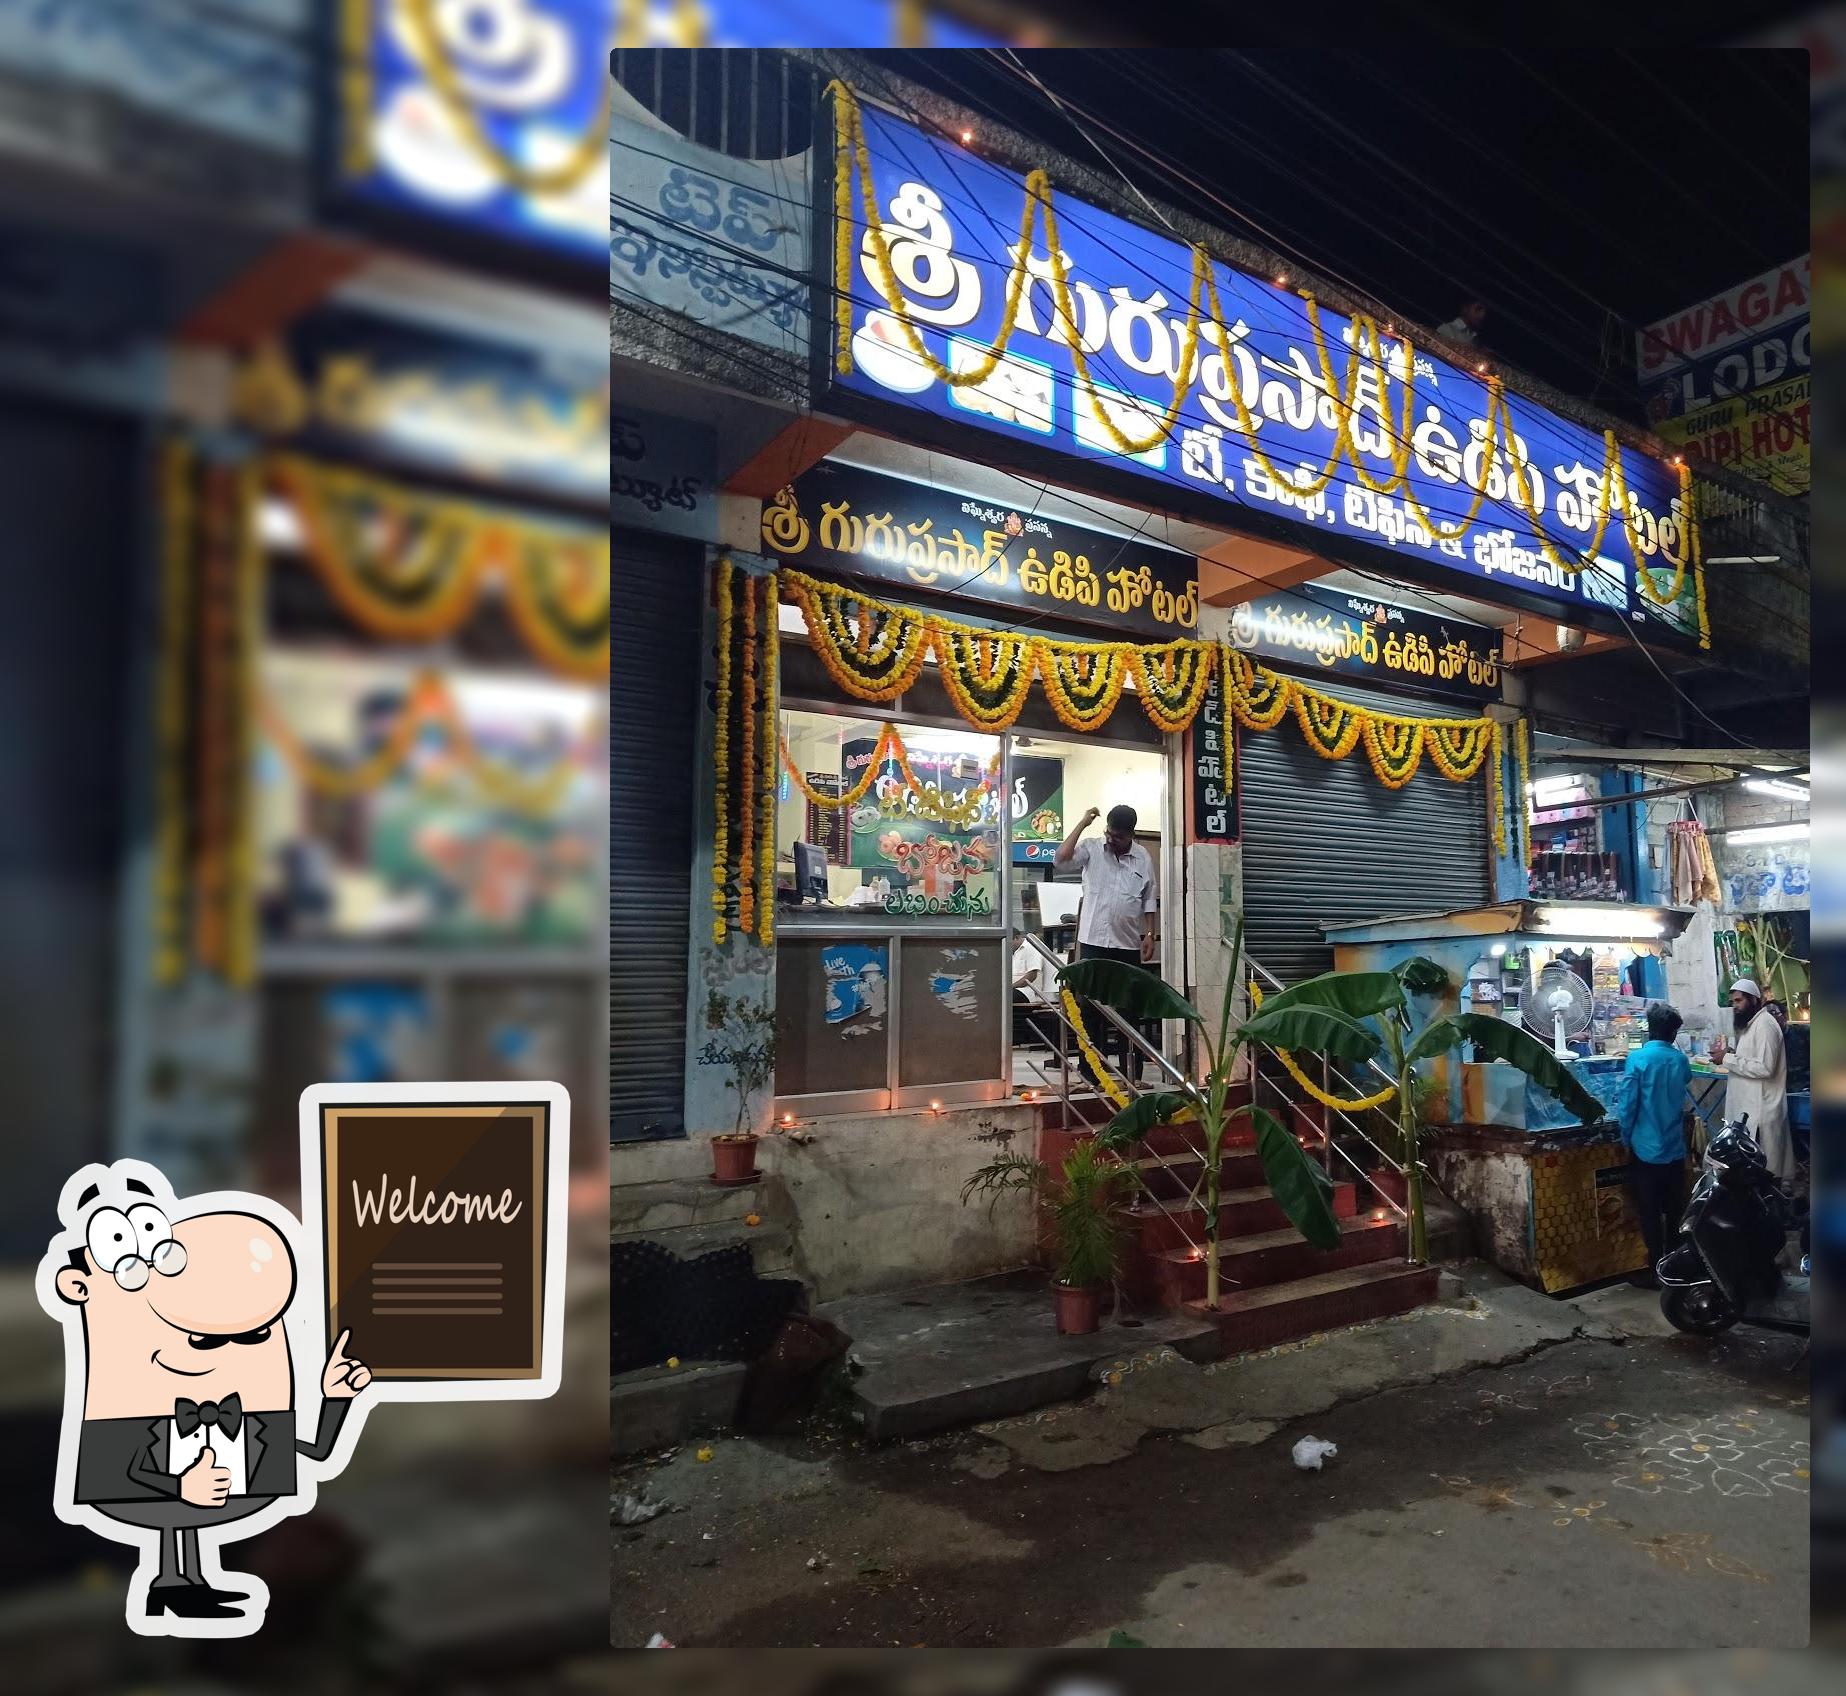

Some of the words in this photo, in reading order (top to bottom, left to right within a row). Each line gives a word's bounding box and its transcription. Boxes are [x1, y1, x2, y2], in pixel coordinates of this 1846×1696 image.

[1643, 262, 1810, 369] SWAGA
[860, 182, 981, 325] శ్రీ
[1413, 406, 1544, 515] ఉడిపి
[1556, 462, 1691, 562] హోటల్
[1686, 407, 1733, 435] GURU
[1745, 381, 1810, 417] PRASA
[762, 484, 810, 553] శ్రీ
[819, 500, 1009, 586] గురుప్రసాద్
[1017, 547, 1099, 606] ఉడిపి
[1106, 564, 1198, 628] హోటల్
[1025, 518, 1052, 539] ప్రసన్న
[1440, 521, 1466, 559] &
[1264, 605, 1377, 665] గురుప్రసాద్
[1383, 632, 1434, 676] ఉడిపి
[1439, 640, 1499, 688] హోటల్
[1042, 848, 1056, 861] pe
